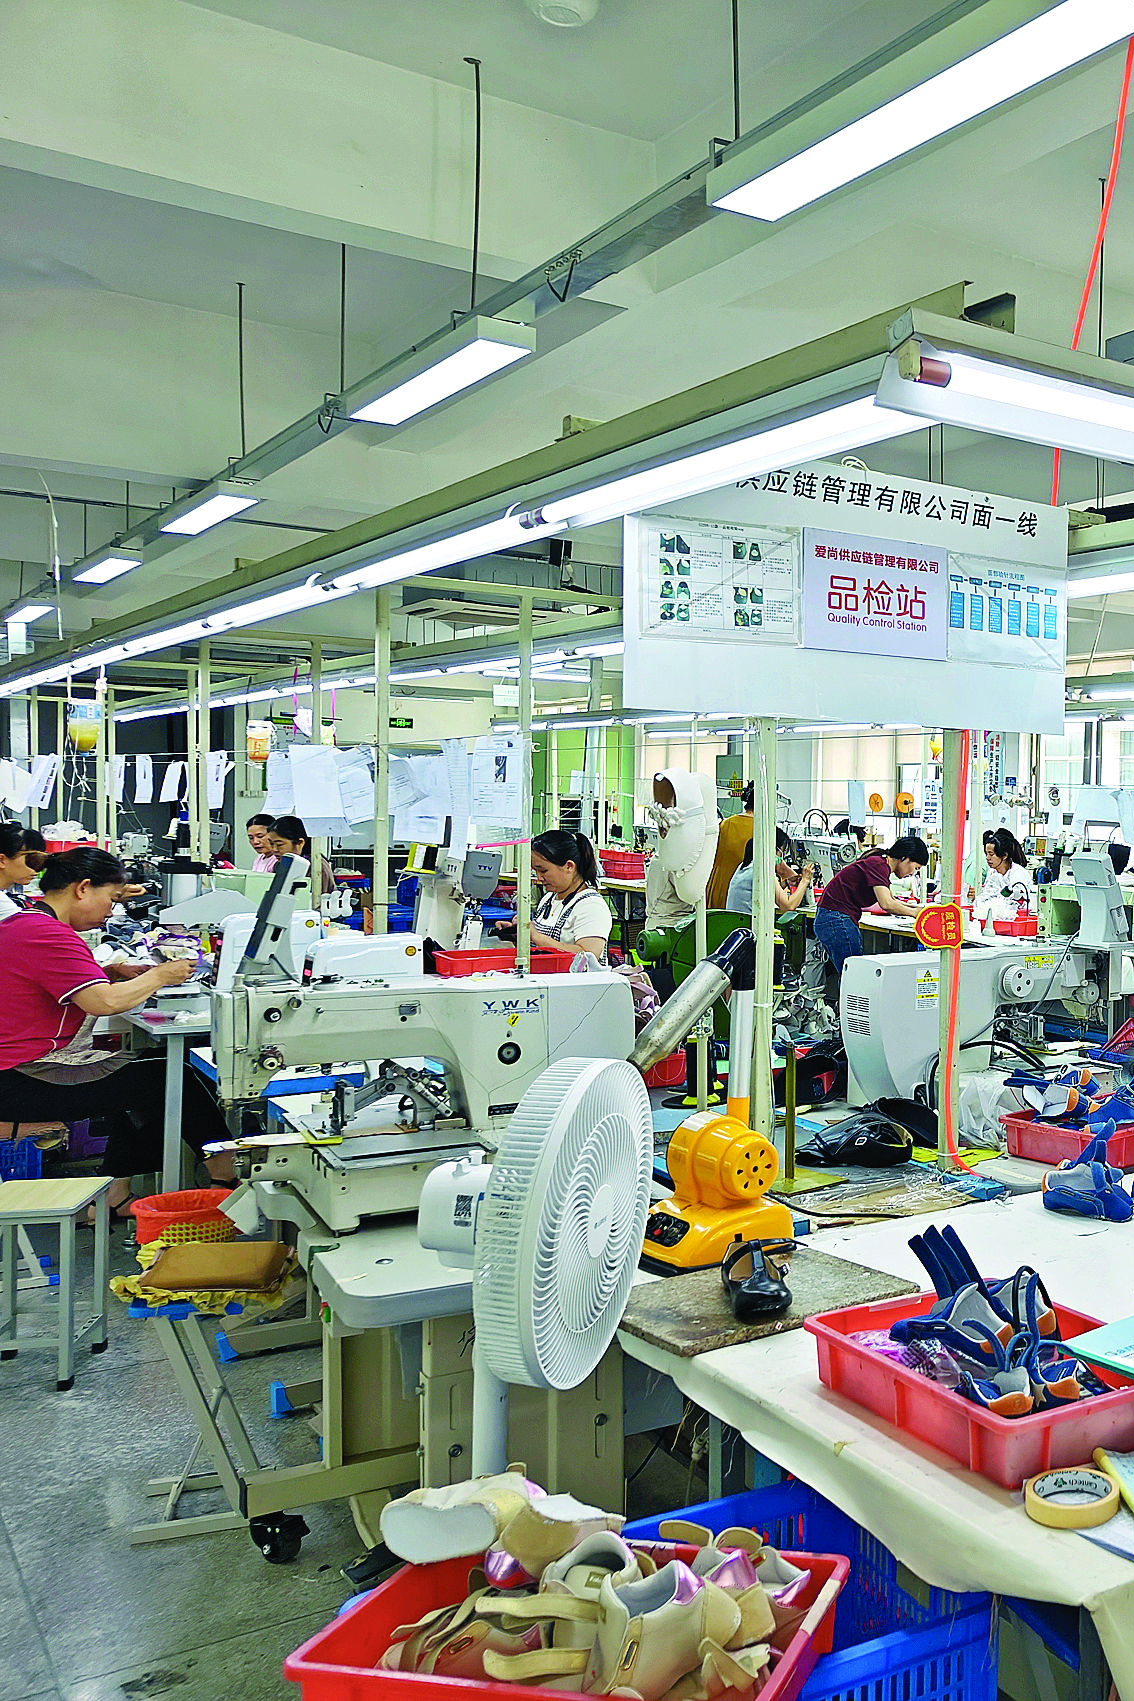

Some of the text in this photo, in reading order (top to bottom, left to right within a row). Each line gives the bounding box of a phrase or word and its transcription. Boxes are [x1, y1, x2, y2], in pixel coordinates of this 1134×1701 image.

[814, 544, 940, 574] 爱尚供应链管理有限公司
[827, 574, 927, 620] 品检站
[827, 612, 927, 632] Quality Control Station
[477, 864, 493, 872] TTY
[482, 998, 539, 1010] YWK
[1068, 1478, 1098, 1490] Cantech
